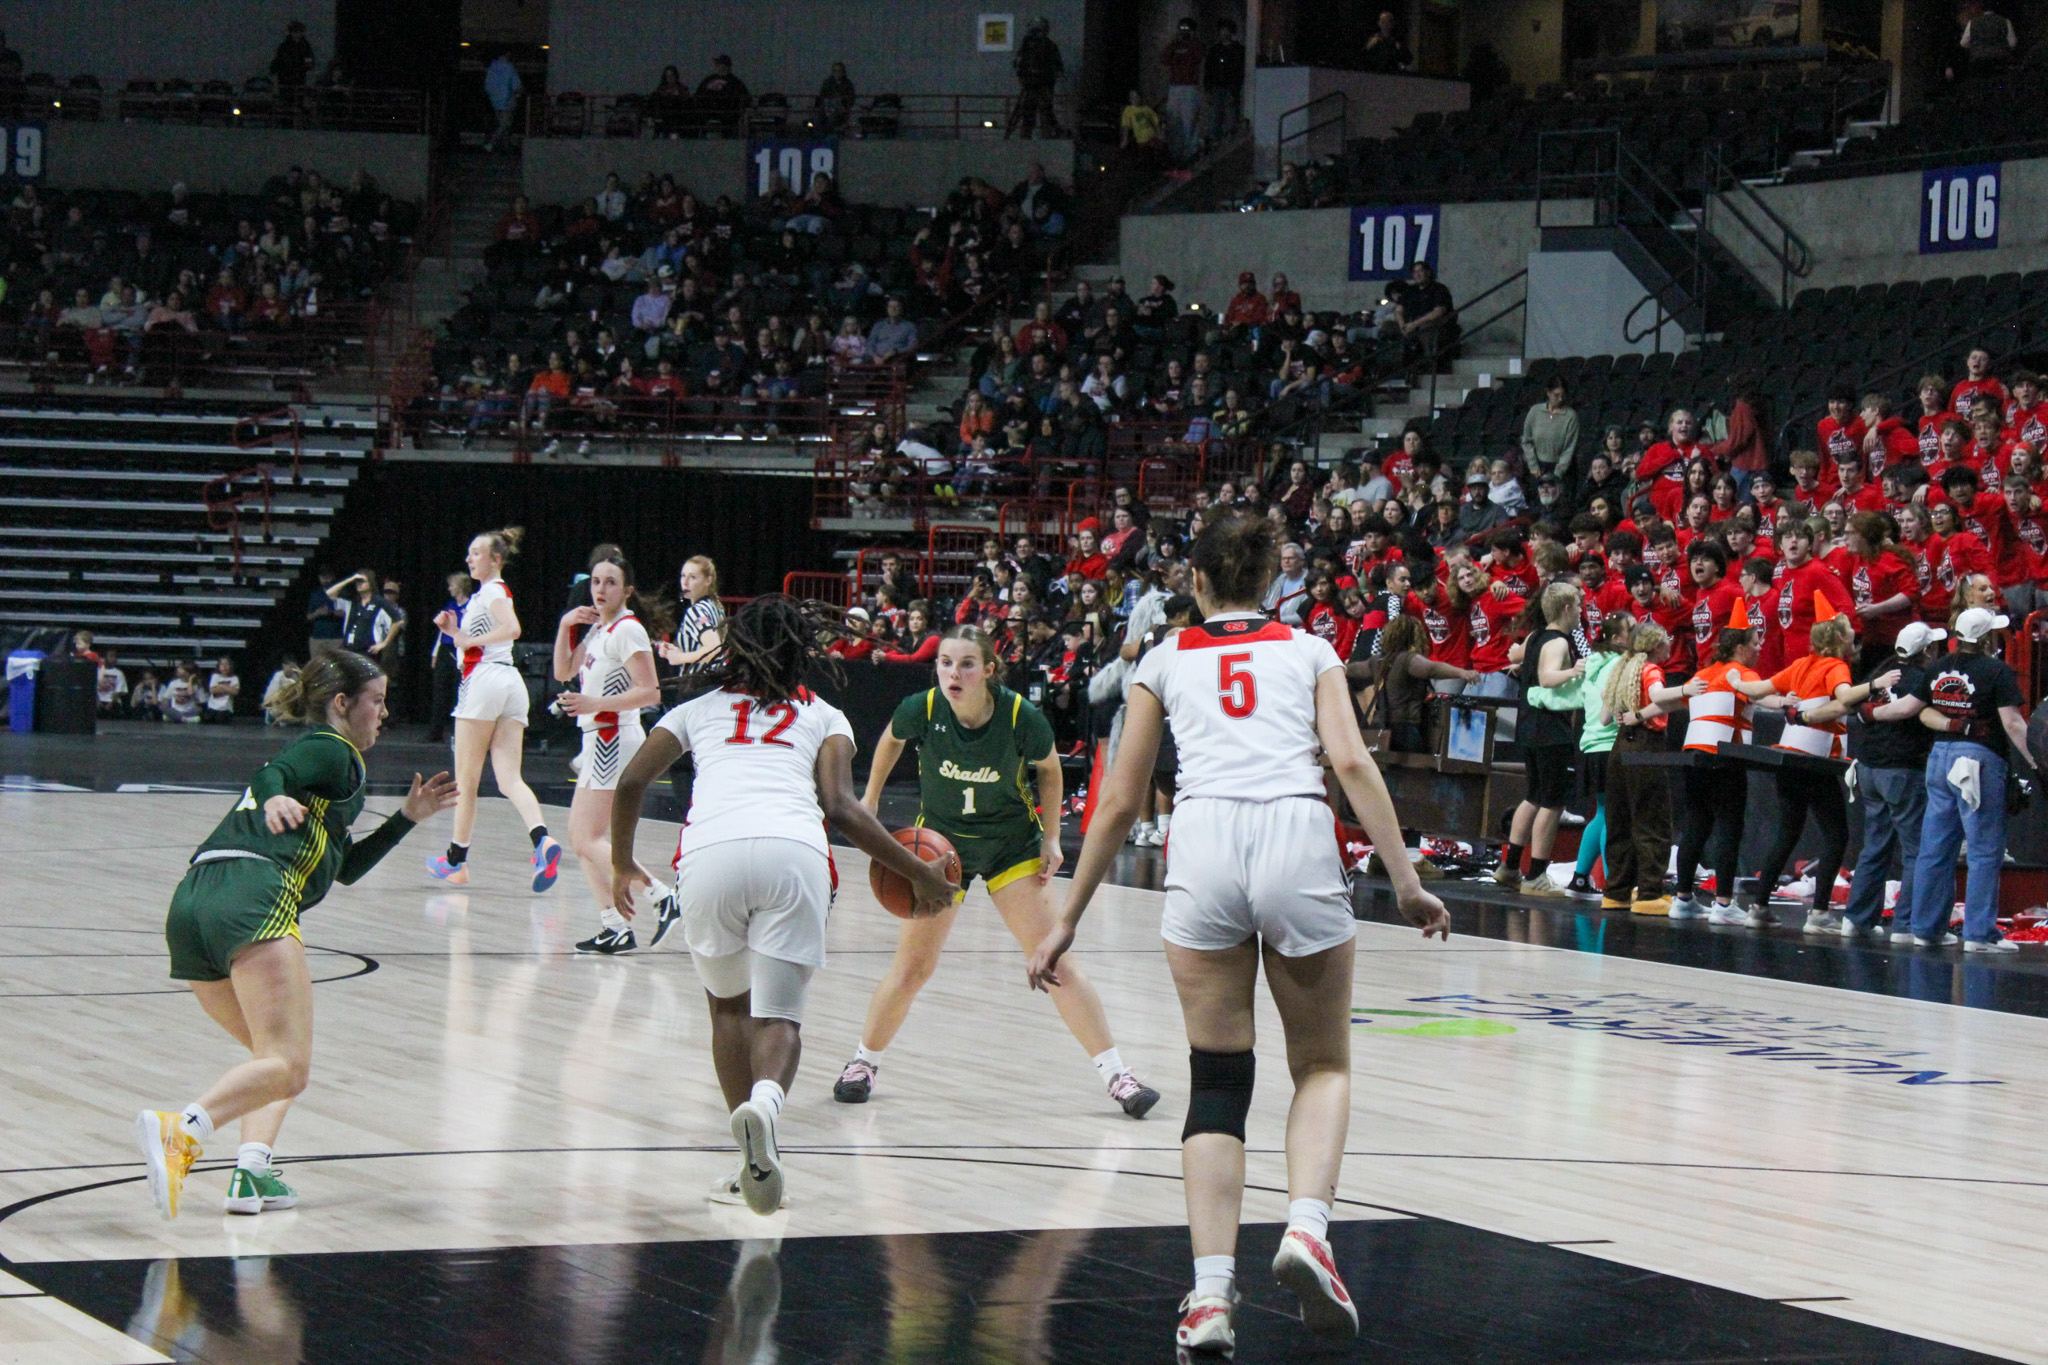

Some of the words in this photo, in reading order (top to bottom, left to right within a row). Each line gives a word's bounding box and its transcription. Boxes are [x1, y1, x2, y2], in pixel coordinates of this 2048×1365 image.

[755, 147, 834, 197] 108
[1928, 174, 1997, 243] 106
[1359, 214, 1434, 272] 107
[1218, 651, 1258, 720] 5
[1932, 698, 1973, 708] MECHANICS
[725, 698, 799, 749] 12
[938, 759, 1001, 783] Shadle
[961, 786, 977, 815] 1
[1403, 994, 2007, 1086] NUMERICA
